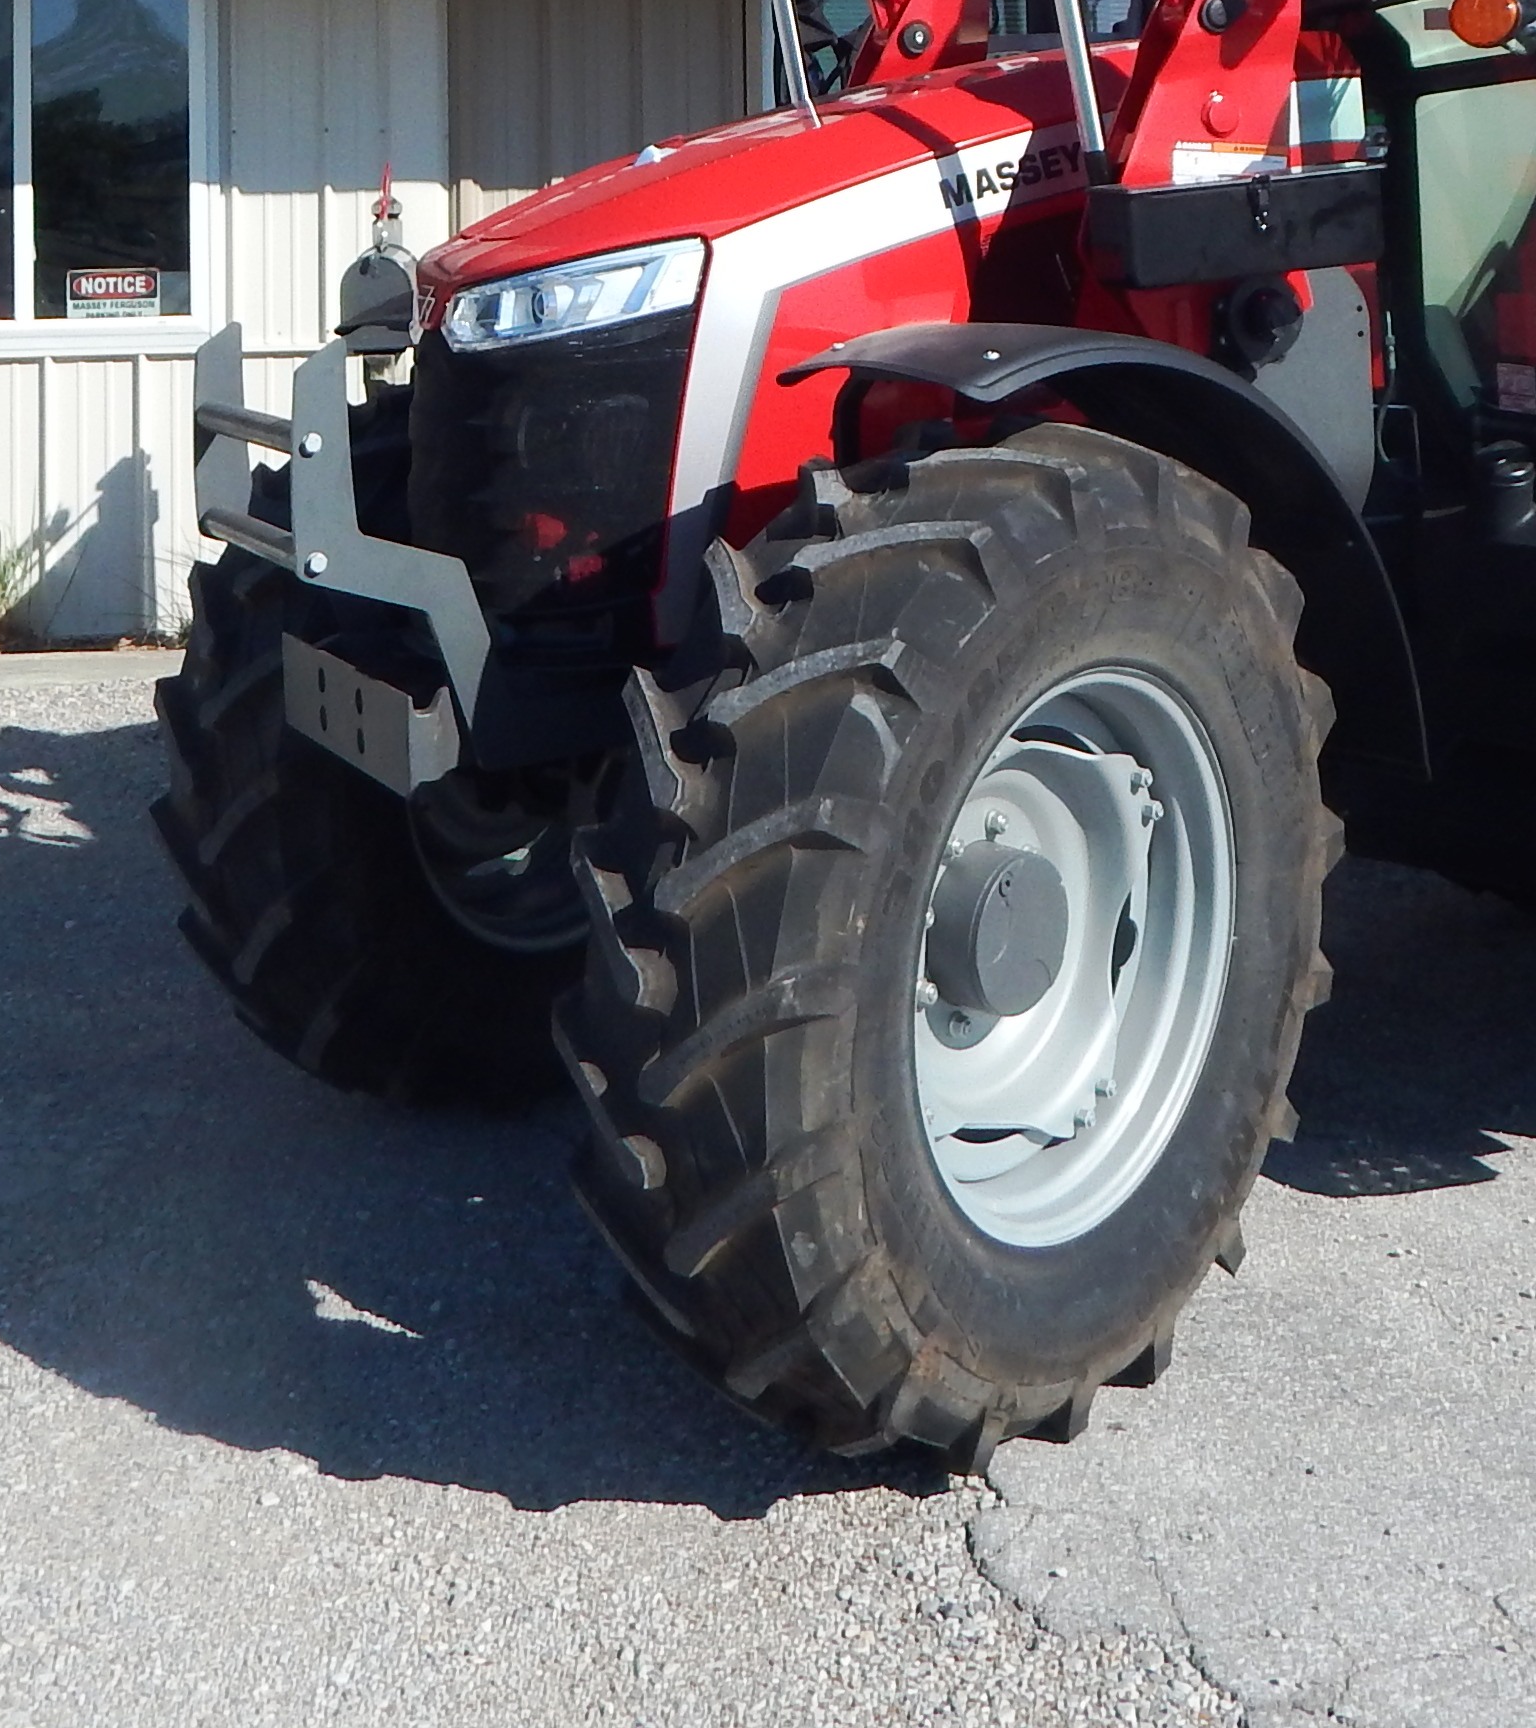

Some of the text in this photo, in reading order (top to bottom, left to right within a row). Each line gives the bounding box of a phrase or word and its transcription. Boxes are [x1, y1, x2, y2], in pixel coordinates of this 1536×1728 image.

[938, 141, 1081, 209] MASSEY
[81, 276, 147, 294] NOTICE
[73, 300, 155, 310] MASSEY FERGUSON
